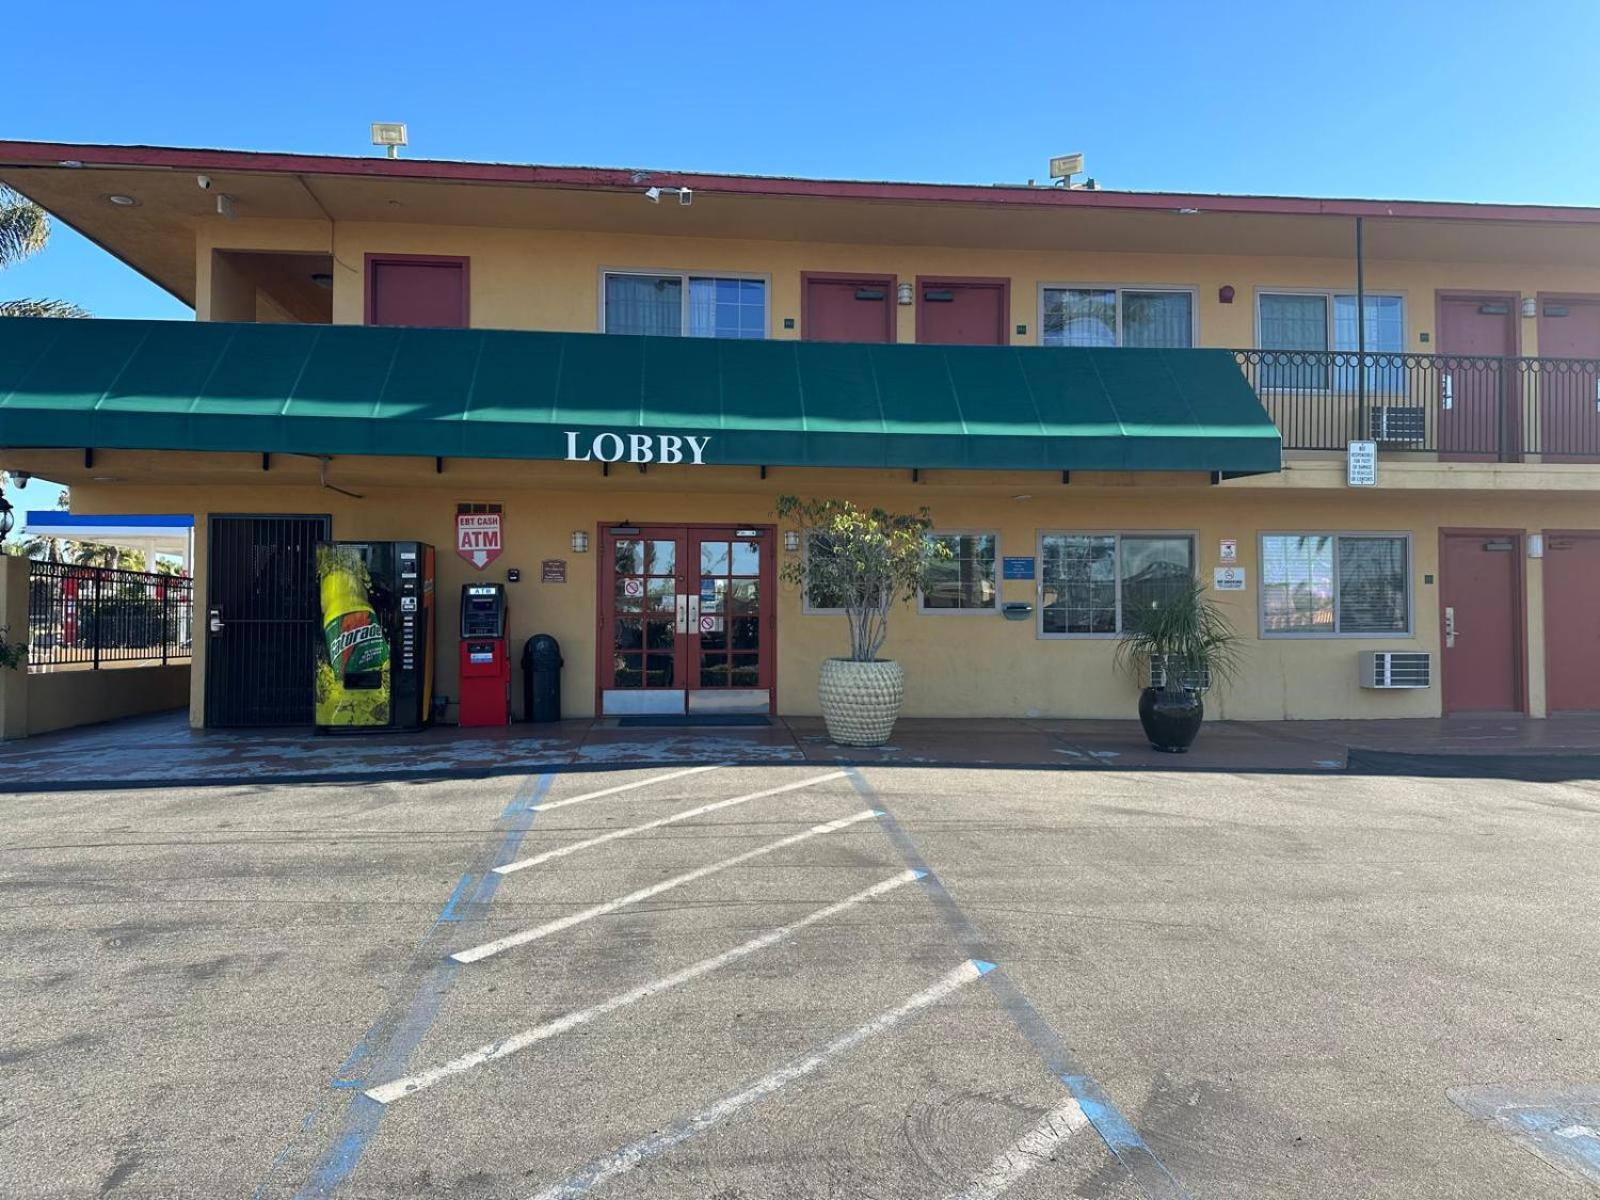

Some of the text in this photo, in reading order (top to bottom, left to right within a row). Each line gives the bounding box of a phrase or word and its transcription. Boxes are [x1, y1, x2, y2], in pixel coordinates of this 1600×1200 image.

[563, 431, 712, 465] LOBBY
[460, 517, 498, 526] EBT CASH
[461, 531, 498, 548] ATM
